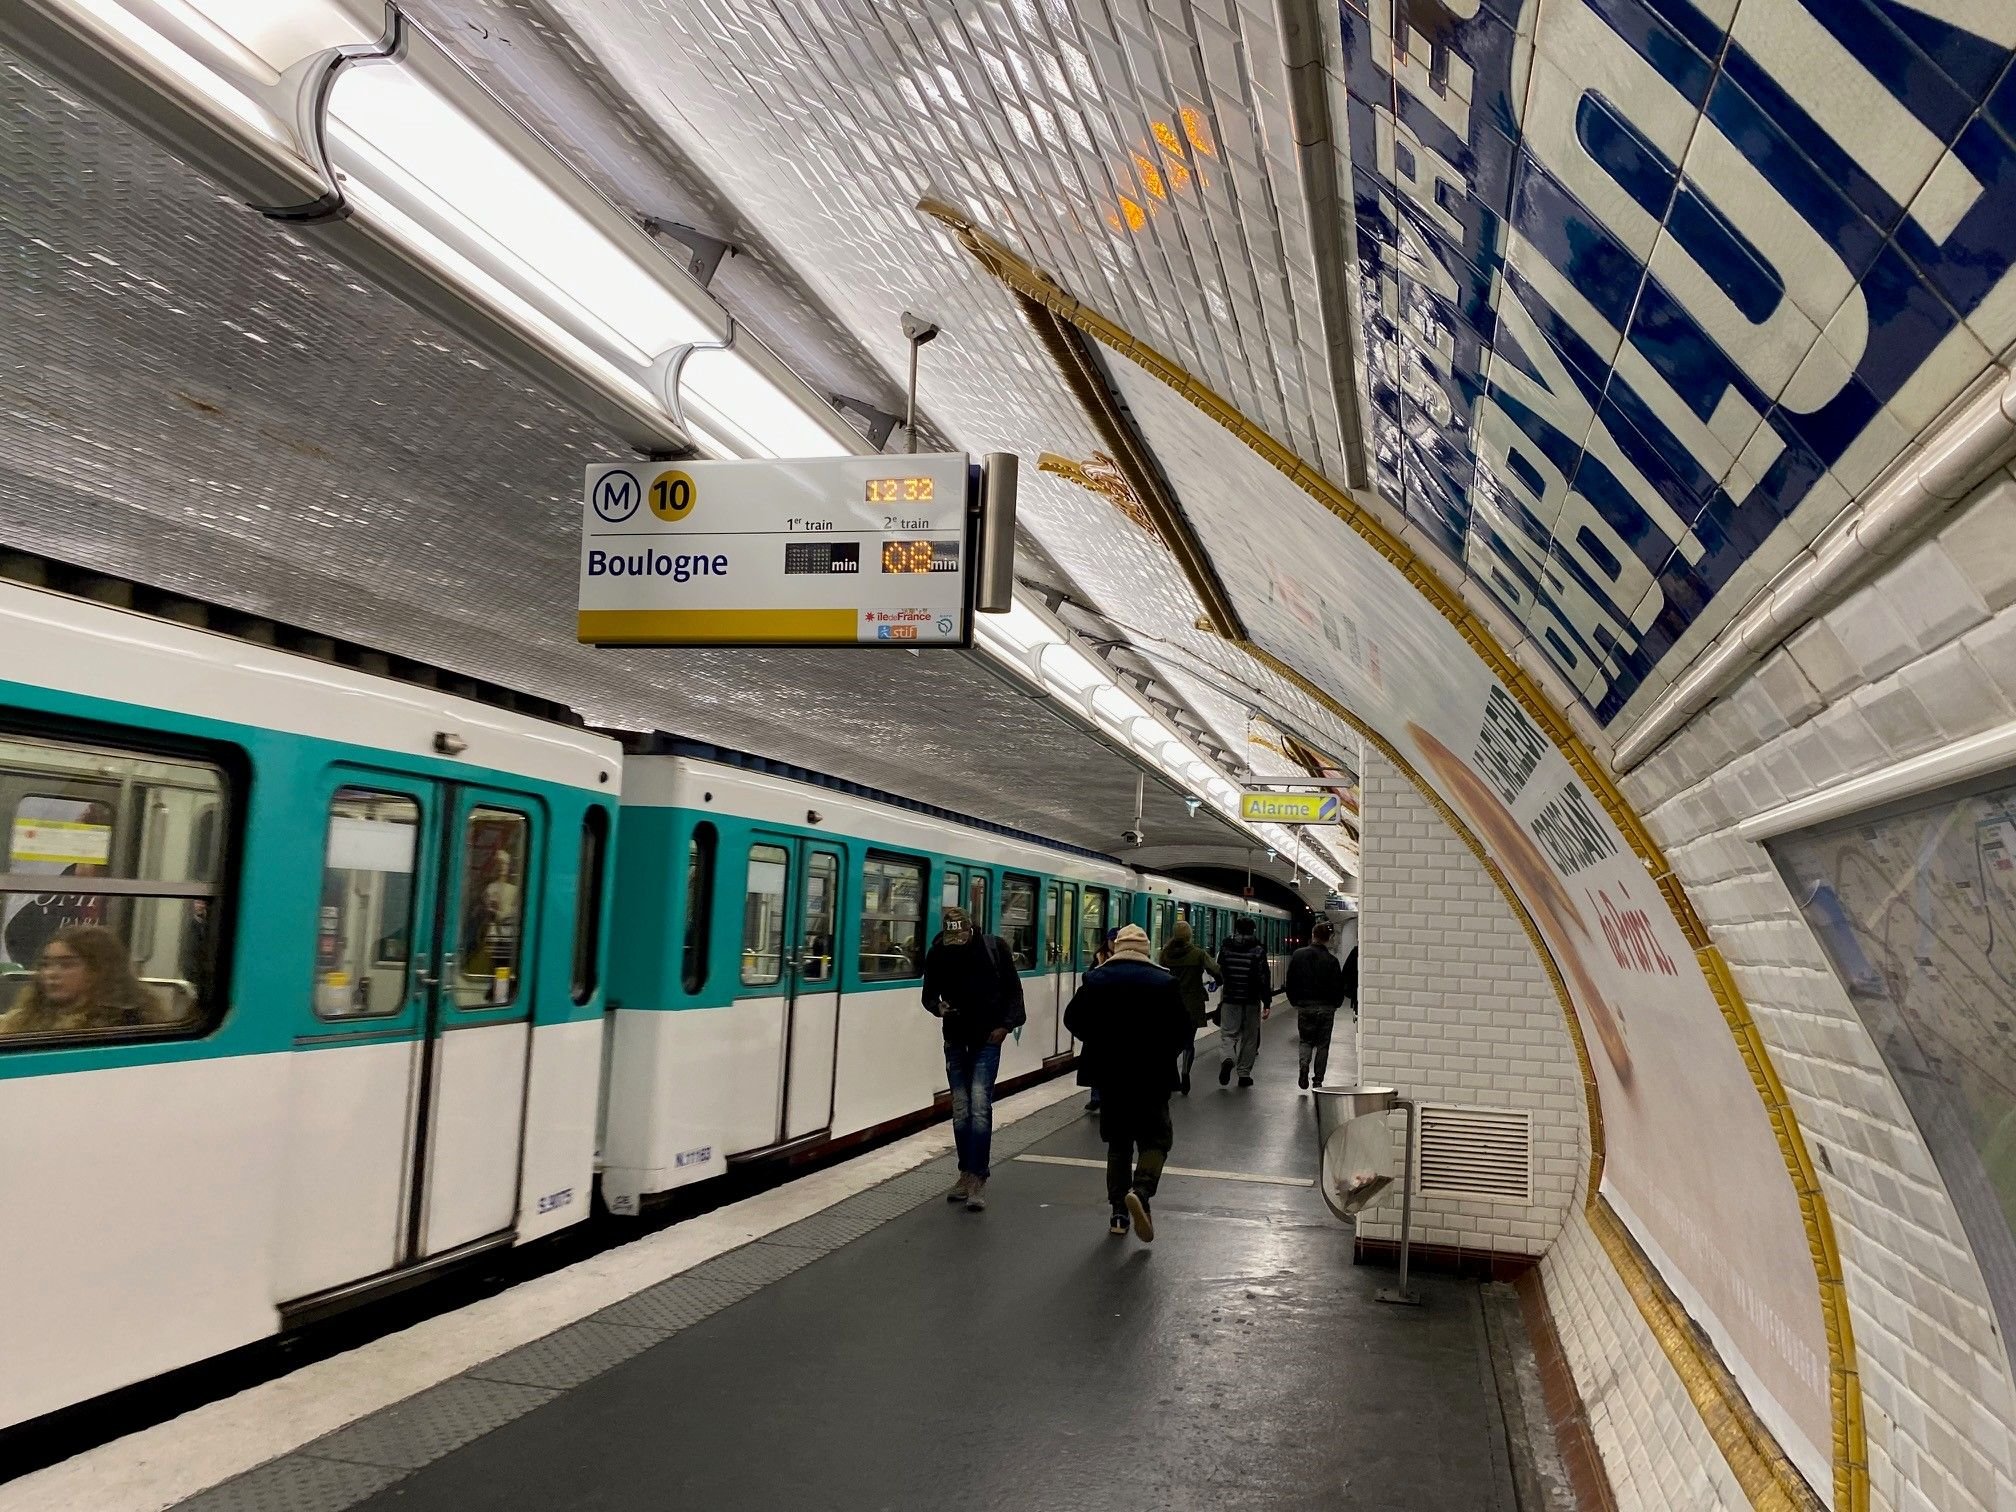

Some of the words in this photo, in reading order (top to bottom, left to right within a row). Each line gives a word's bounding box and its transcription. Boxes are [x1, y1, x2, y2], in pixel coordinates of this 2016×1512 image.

[1361, 0, 1479, 427] SÈVRE
[653, 479, 690, 510] 10
[805, 519, 833, 530] train
[900, 518, 929, 529] train
[588, 548, 728, 583] Boulogne
[831, 558, 857, 571] min
[930, 557, 957, 570] min
[893, 626, 915, 638] stif
[1477, 684, 1550, 798] MEILLEUR
[1472, 750, 1516, 806] LE
[1249, 799, 1310, 817] Alarme
[1530, 781, 1619, 877] CROISSANT
[1584, 887, 1631, 971] de
